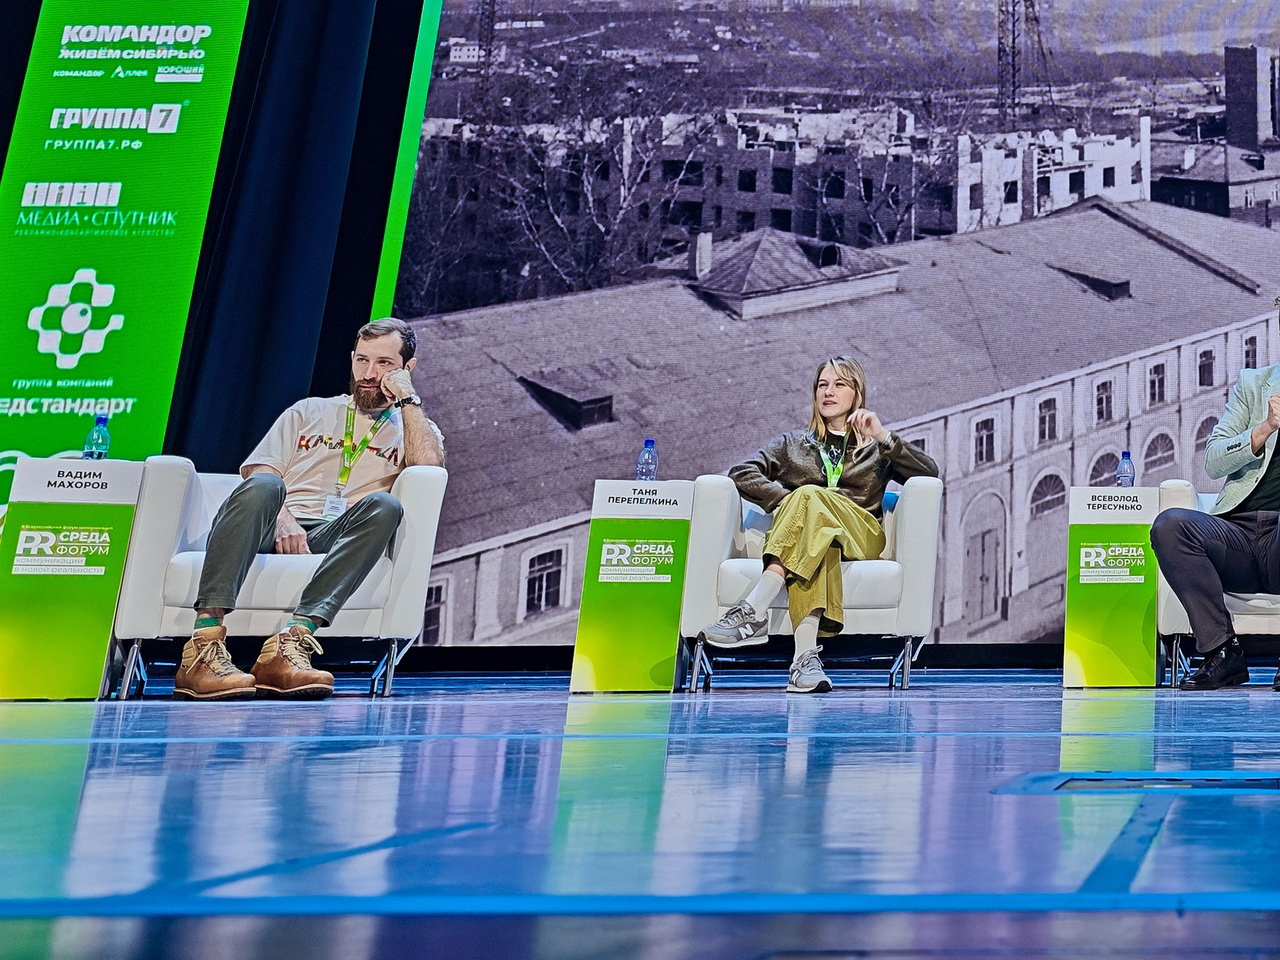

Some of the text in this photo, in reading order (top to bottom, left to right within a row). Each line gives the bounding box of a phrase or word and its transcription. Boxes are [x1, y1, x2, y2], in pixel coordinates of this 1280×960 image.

[61, 25, 212, 45] КОМАНДОР
[122, 48, 206, 59] СИБИРЬЮ
[44, 140, 143, 150] ГРУППА7.РФ
[12, 378, 53, 390] группа
[57, 470, 102, 480] ВАДИМ
[47, 480, 108, 490] МАХОРОВ
[632, 488, 657, 496] ТАНЯ
[608, 496, 678, 506] ПЕРЕПЕЛКИНА
[1091, 495, 1139, 503] ВСЕВОЛОД
[1086, 503, 1142, 511] ТЕРЕСУНЬКО
[60, 532, 111, 543] СРЕДА
[16, 531, 57, 555] PR
[56, 545, 110, 555] ФОРУМ
[633, 544, 674, 554] СРЕДА
[1108, 547, 1145, 556] СРЕДА
[601, 544, 631, 565] PR
[1080, 547, 1106, 567] PR
[632, 556, 674, 565] ФОРУМ
[1107, 559, 1145, 567] ФОРУМ
